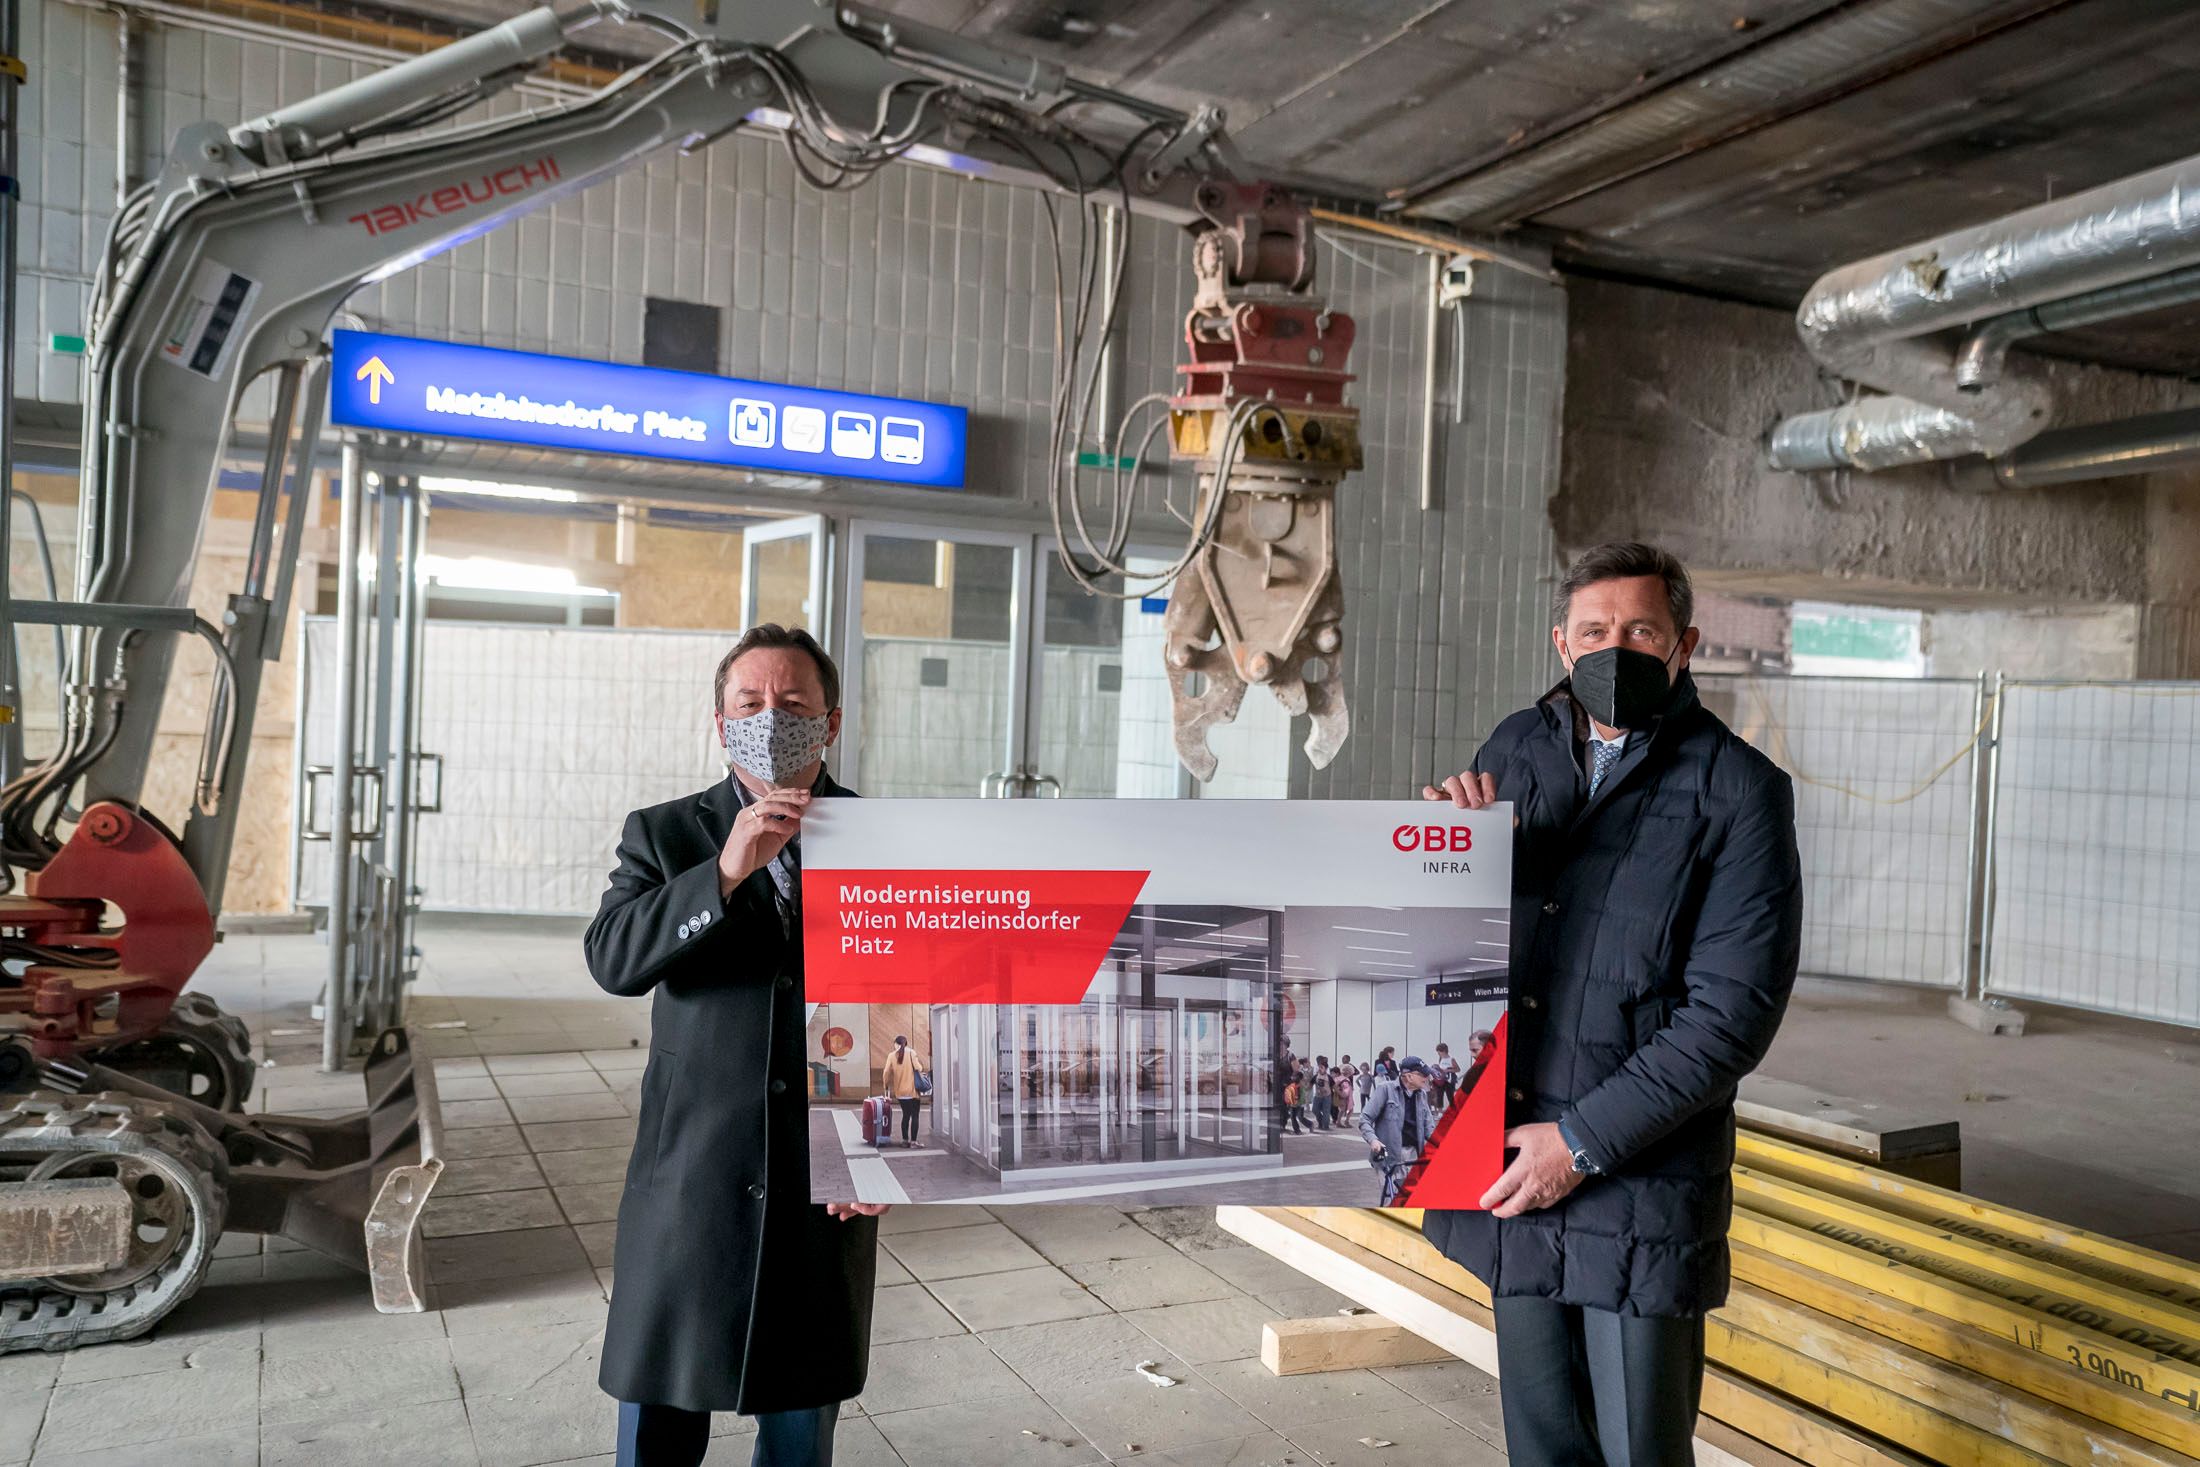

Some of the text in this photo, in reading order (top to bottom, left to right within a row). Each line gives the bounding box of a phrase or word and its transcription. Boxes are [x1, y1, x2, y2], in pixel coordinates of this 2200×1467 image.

[425, 385, 707, 441] Matzleinsdorfer Platz
[1423, 862, 1472, 873] INFRA
[839, 885, 1031, 909] Modernisierung
[840, 911, 1081, 930] Wien Matzleinsdorfer
[841, 936, 894, 954] Platz
[1474, 988, 1492, 996] Wien
